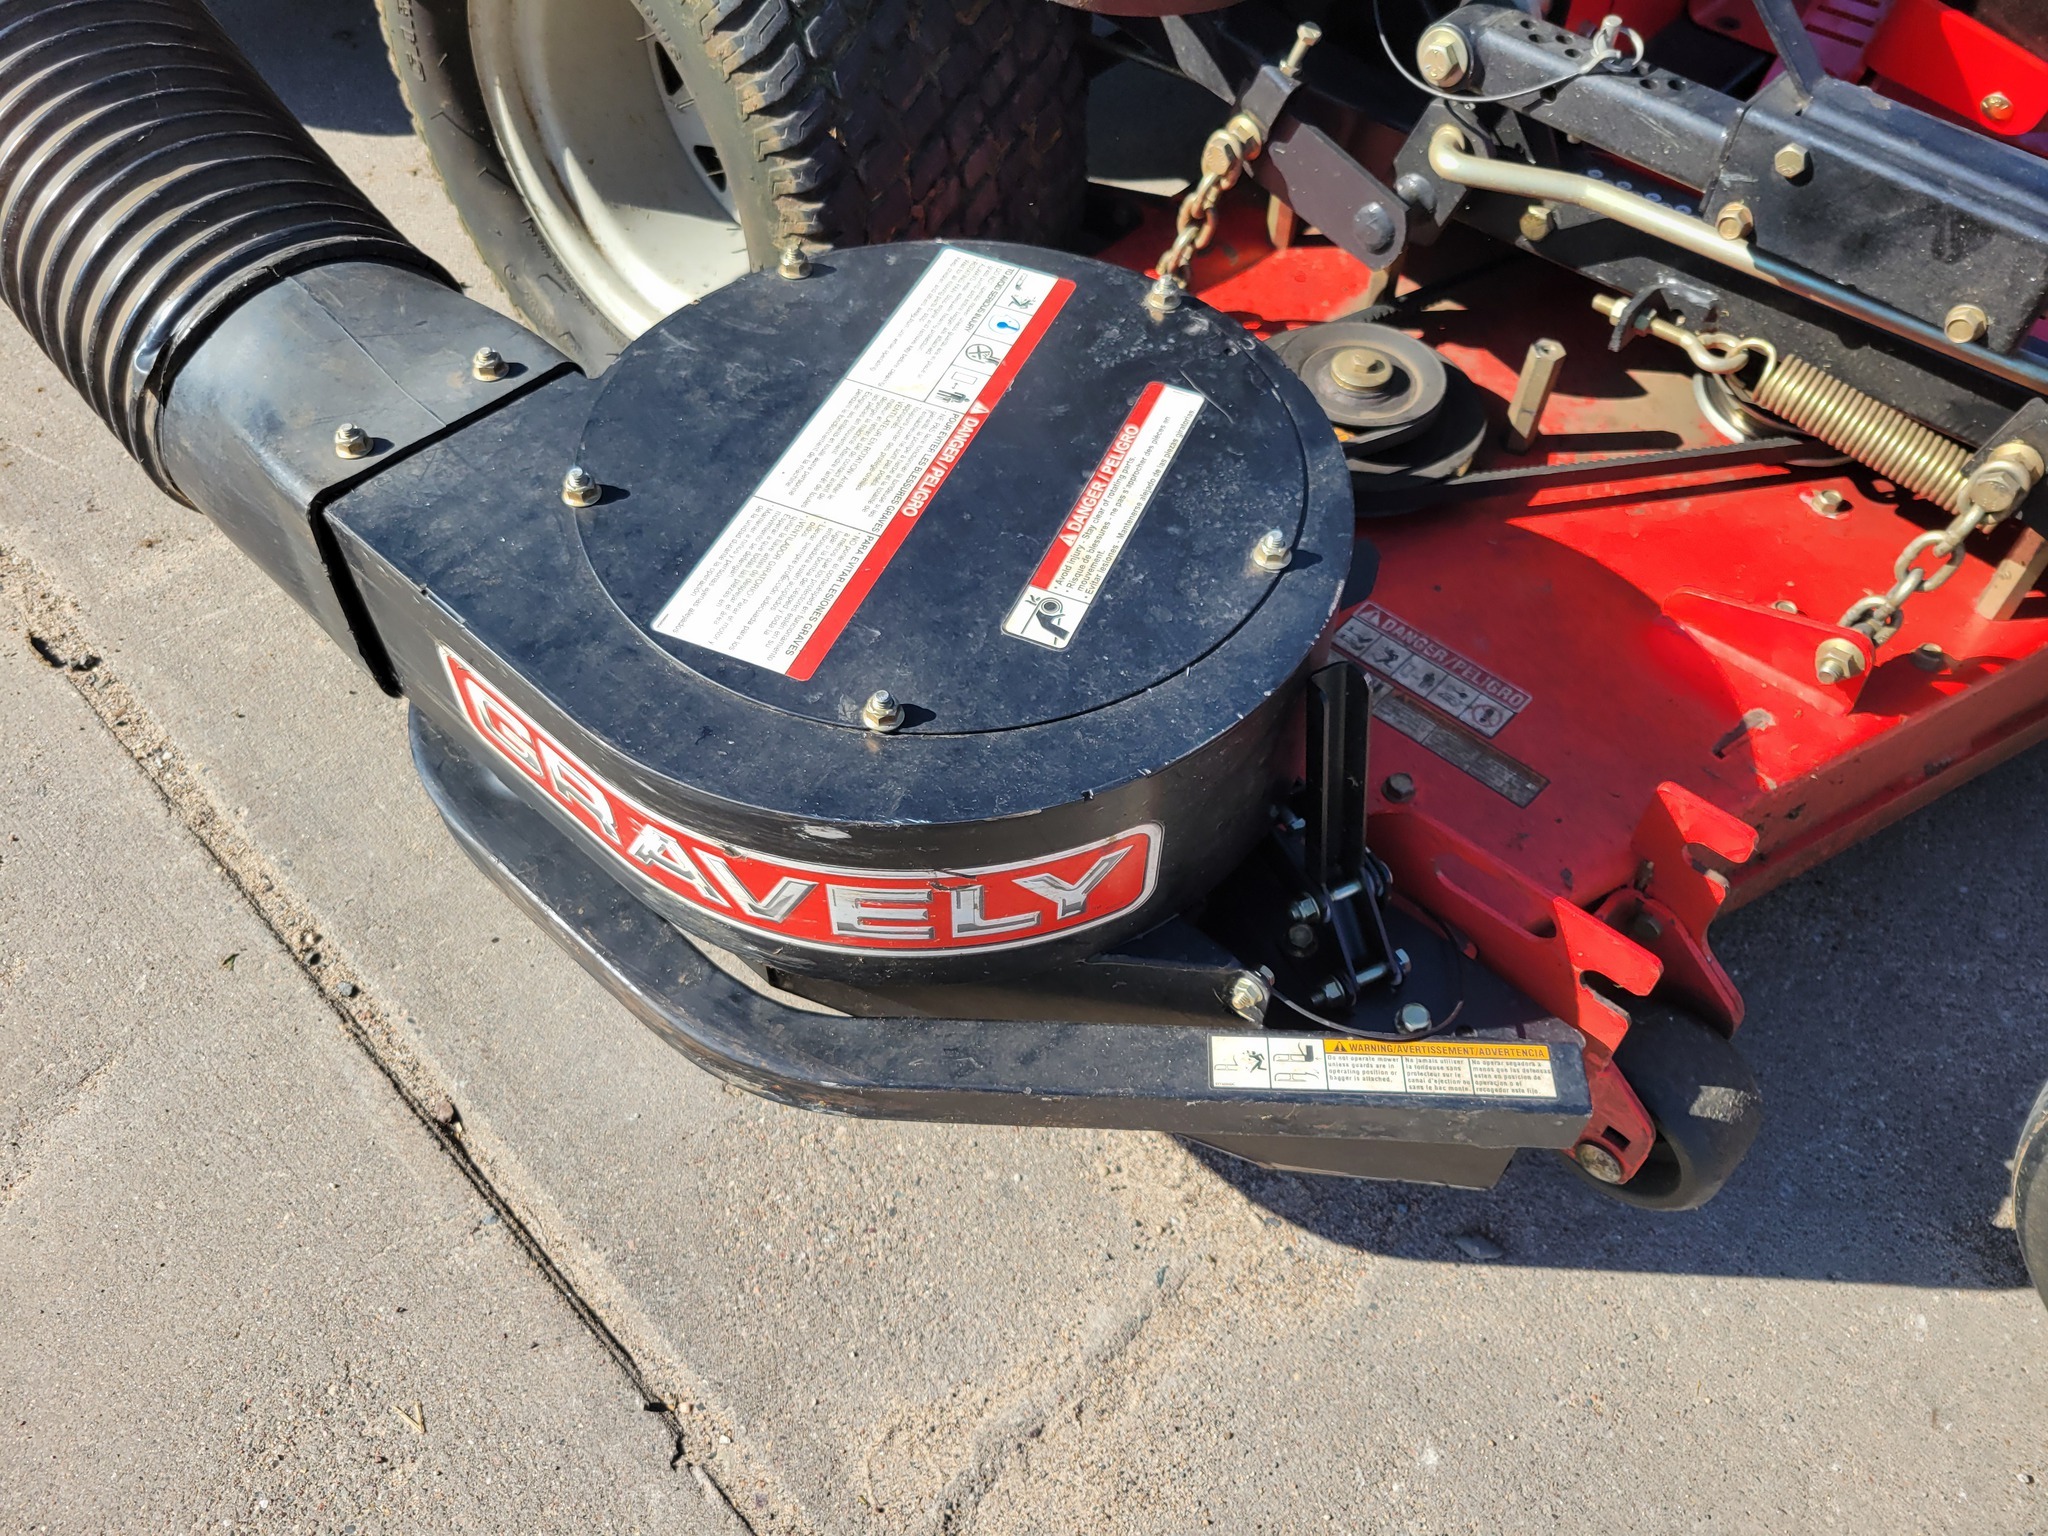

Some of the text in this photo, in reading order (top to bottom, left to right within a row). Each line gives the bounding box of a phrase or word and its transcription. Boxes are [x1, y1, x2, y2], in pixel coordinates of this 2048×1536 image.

[941, 412, 960, 431] POUR
[889, 465, 923, 505] BLESSURES
[916, 452, 932, 467] LES
[1065, 423, 1140, 532] DANGER PELIGRO
[870, 504, 896, 533] GRAVES
[1054, 455, 1137, 586] Avoid injury Stay clear of rotating parts.
[1065, 415, 1171, 590] Risque de blessures ne pas s'approcher des pièces en
[1084, 408, 1198, 596] Evitar lesiones Mantenerse alejado de las piezas giratorias.
[783, 534, 875, 657] PARA EVITAR LESIONES GRAVES
[1076, 549, 1105, 591] mouvement.
[464, 678, 1134, 941] GRAVELY
[1349, 1043, 1544, 1058] WARNING/AVERTISSEMENT/ADVERTENCIA
